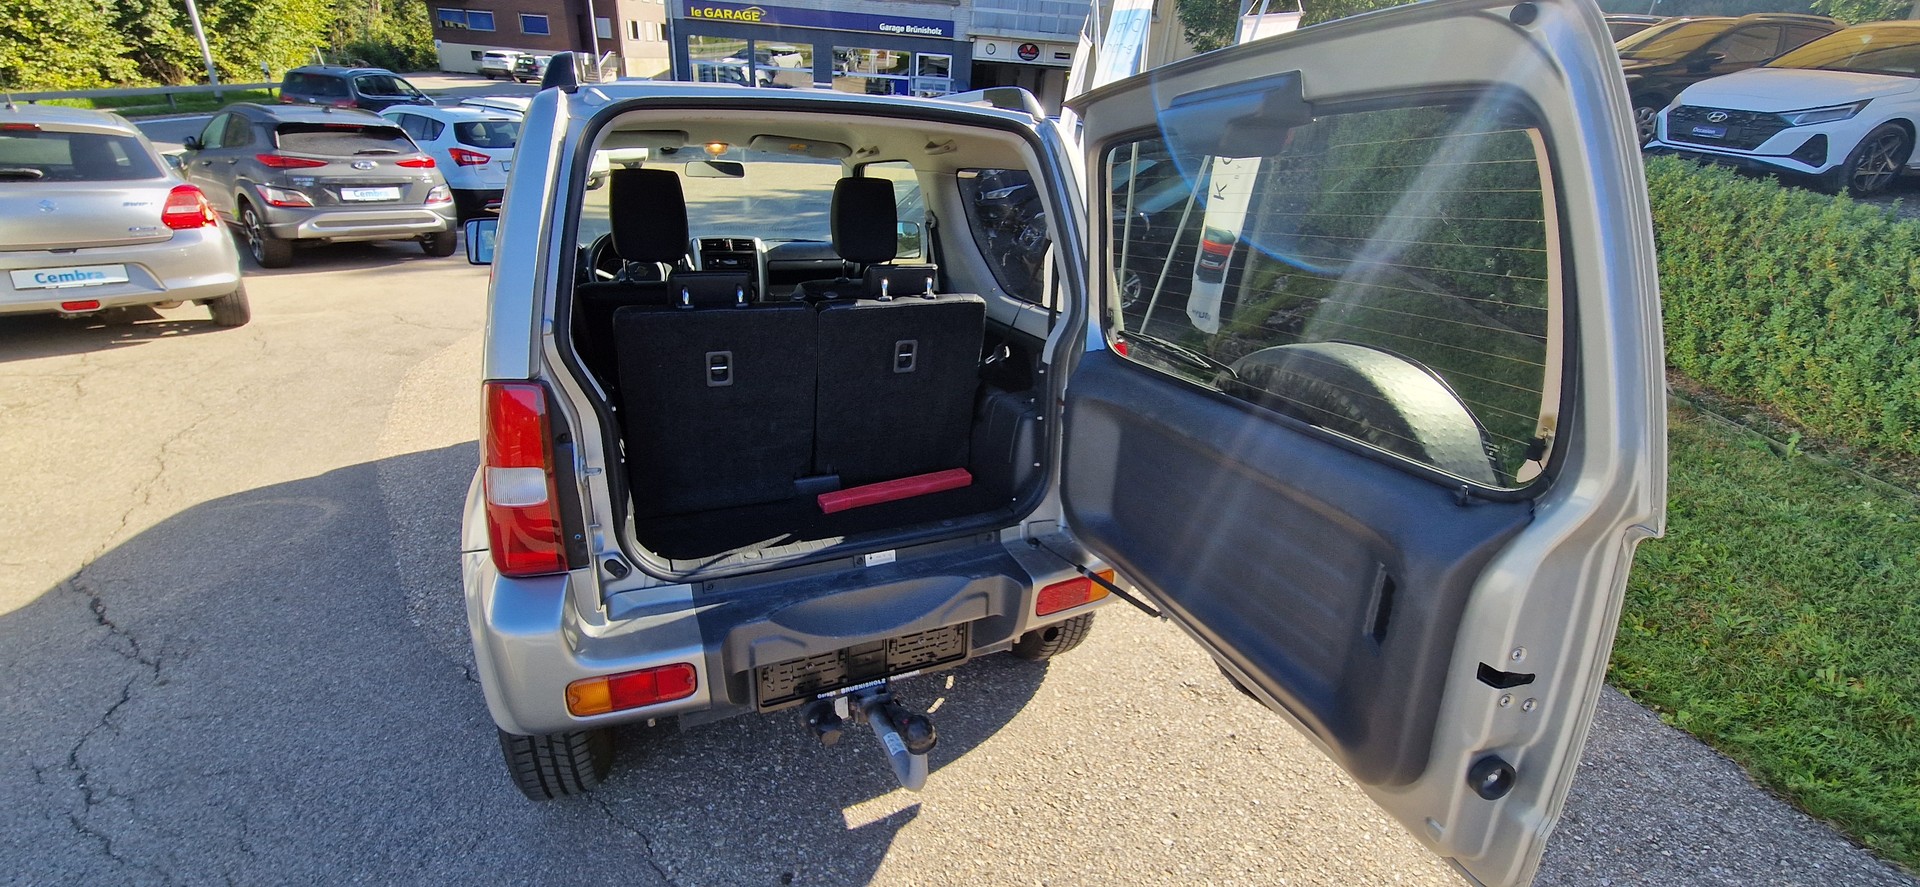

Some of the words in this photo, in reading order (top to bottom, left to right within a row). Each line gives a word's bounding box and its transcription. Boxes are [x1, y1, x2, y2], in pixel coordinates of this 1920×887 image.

[690, 6, 702, 17] le
[703, 7, 761, 22] GARAGE
[879, 22, 905, 34] Garage
[905, 23, 943, 36] Brünisholz
[352, 189, 389, 198] Cembra
[34, 268, 106, 285] Cembra
